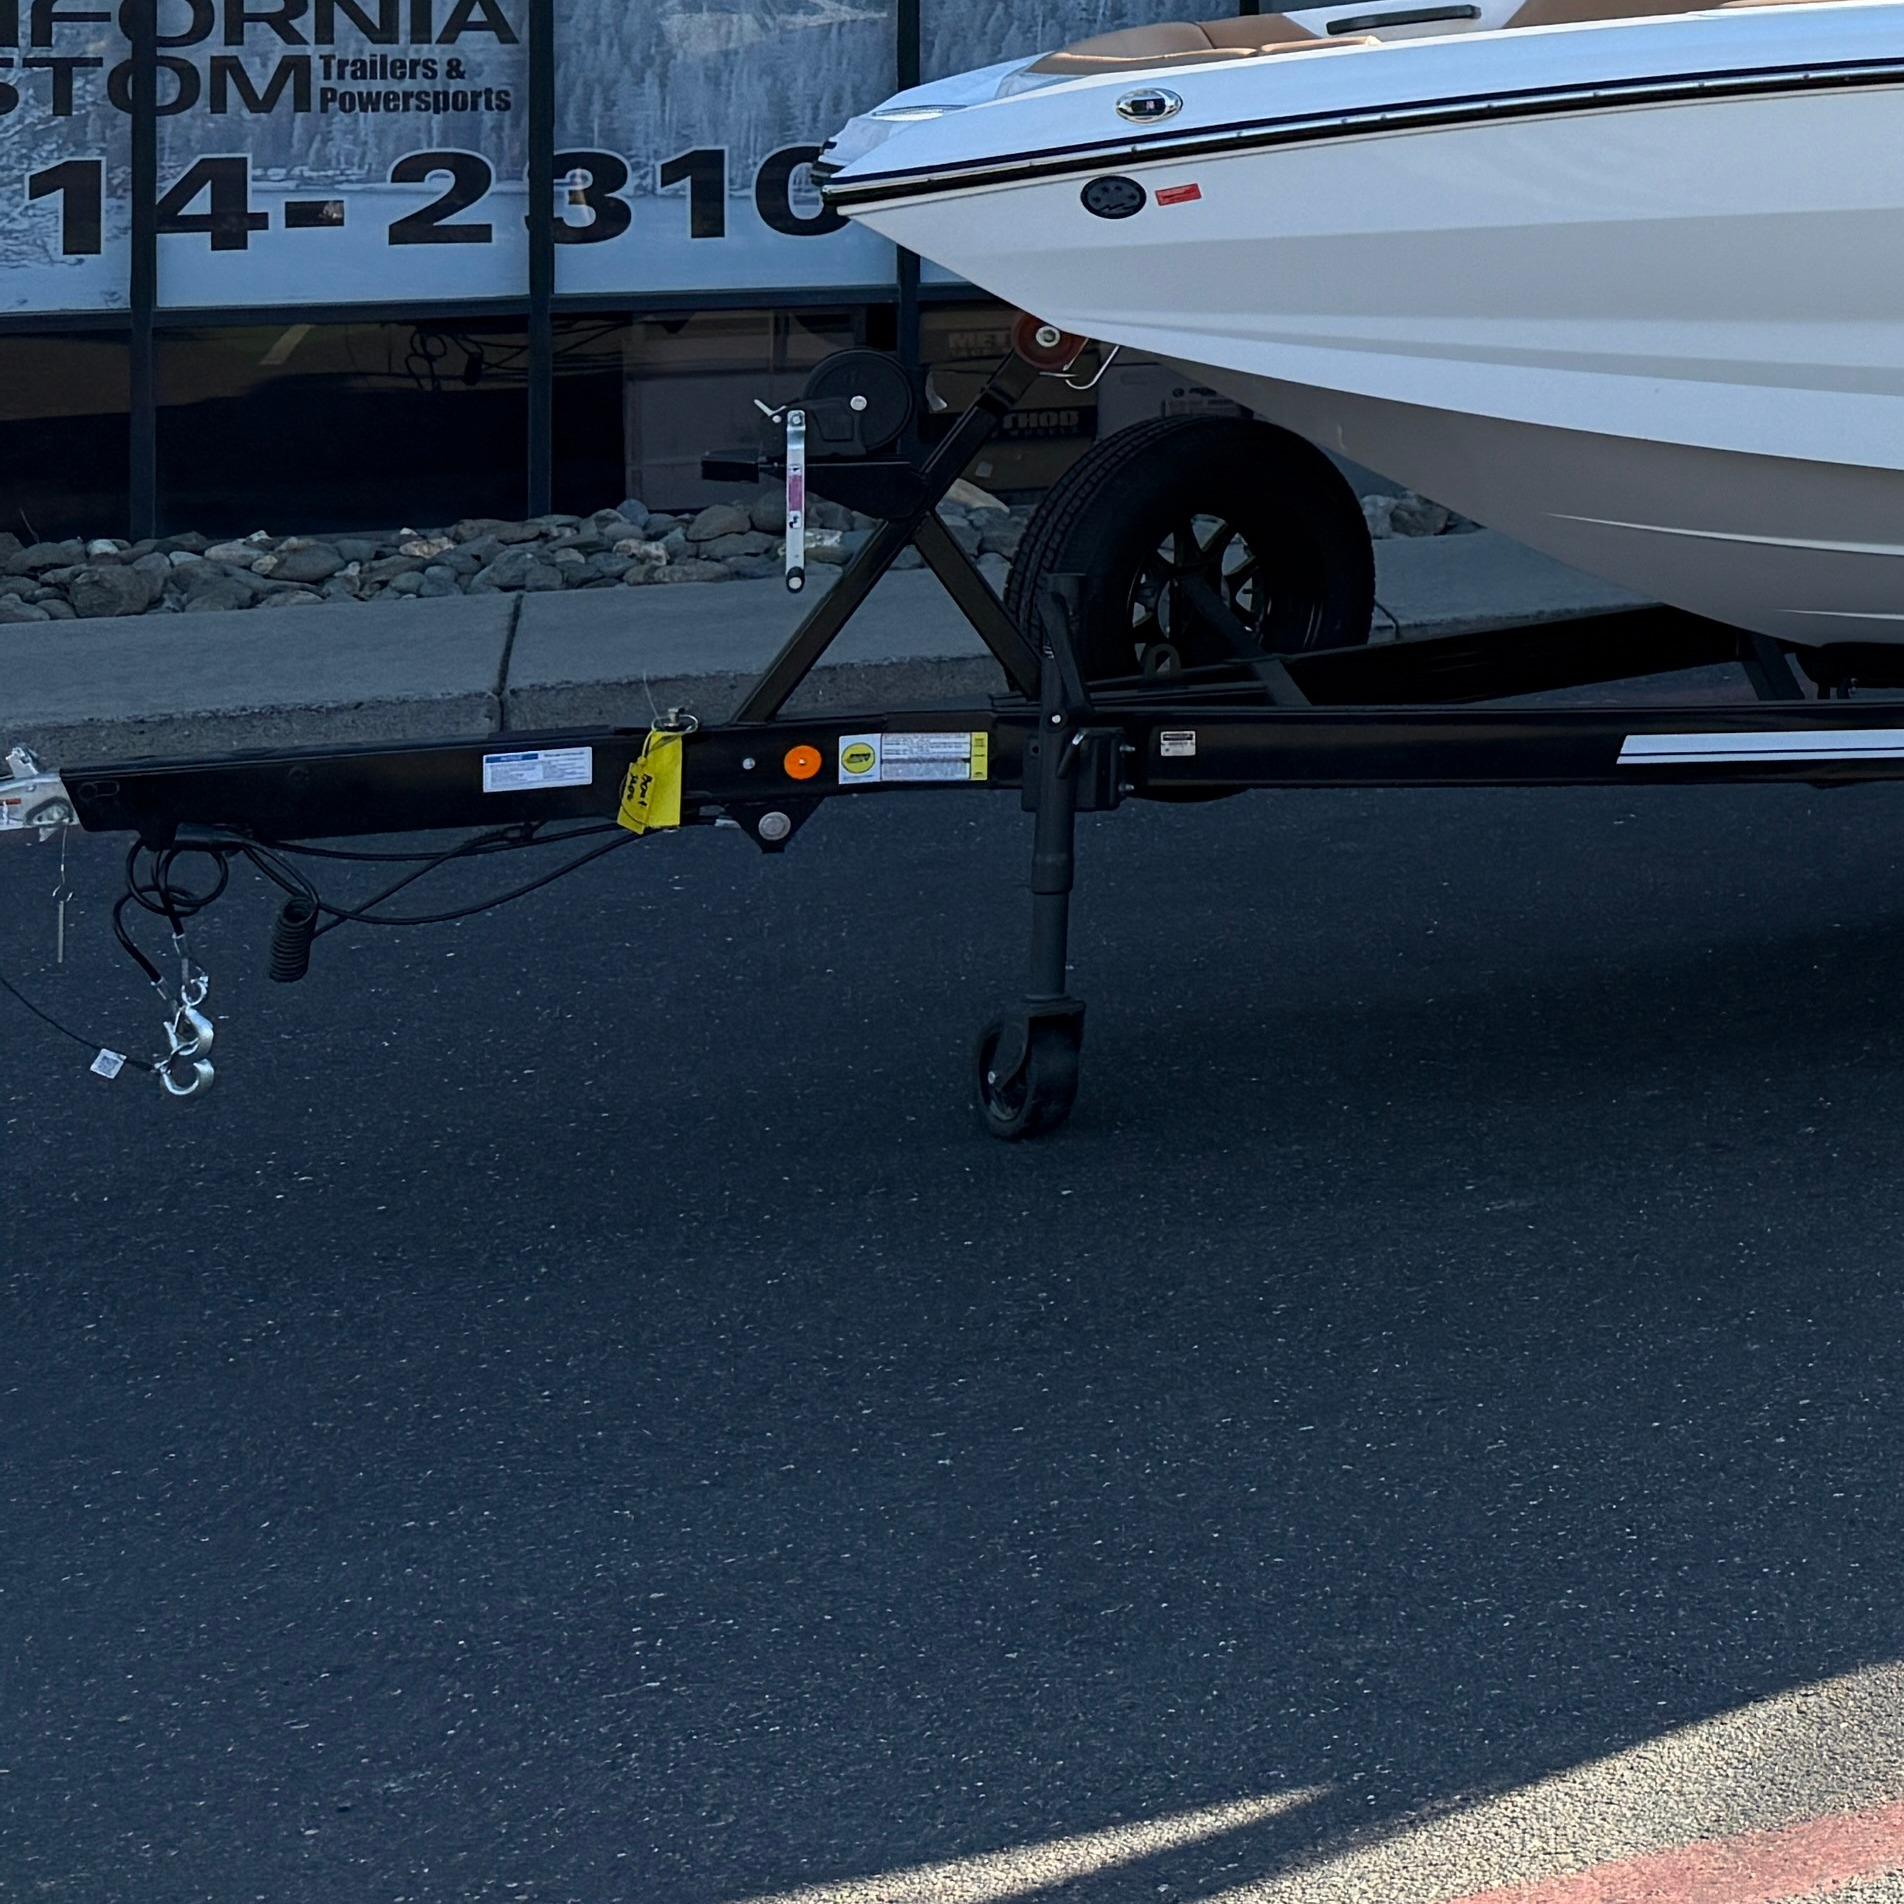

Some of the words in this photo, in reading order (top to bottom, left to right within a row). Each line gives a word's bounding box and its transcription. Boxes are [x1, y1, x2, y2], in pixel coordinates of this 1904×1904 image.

[319, 53, 439, 81] Trailers
[447, 57, 467, 80] &
[0, 55, 311, 116] TOM
[319, 85, 512, 115] Powersports
